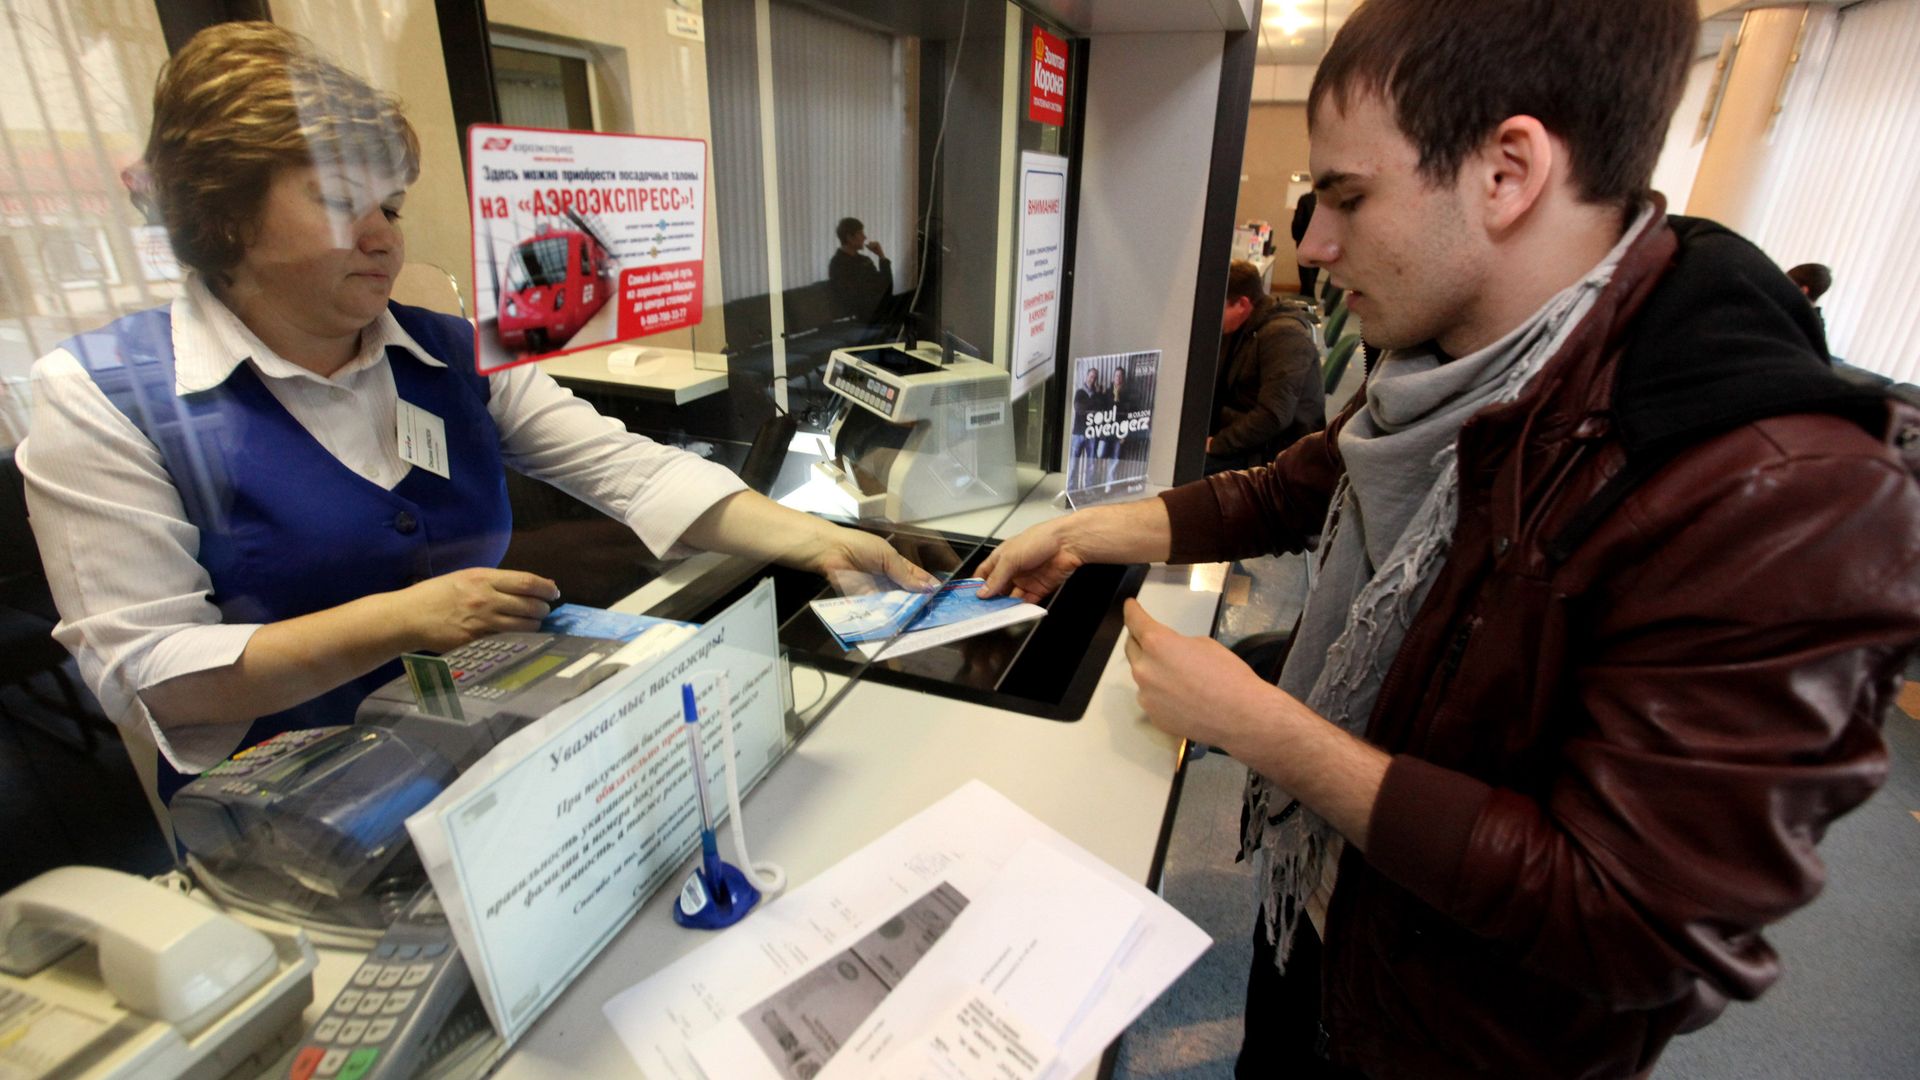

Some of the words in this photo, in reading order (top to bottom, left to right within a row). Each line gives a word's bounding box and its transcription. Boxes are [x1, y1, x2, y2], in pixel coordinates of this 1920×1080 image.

[1035, 60, 1064, 96] Корона
[480, 196, 509, 218] на
[518, 186, 694, 218] «АЭРОЭКСПРЕСС»!
[482, 166, 518, 182] Здесь
[523, 170, 558, 181] можно
[562, 168, 616, 183] приобрести
[619, 170, 669, 181] посадочные
[671, 171, 699, 181] талоны
[1085, 416, 1150, 439] avengerz
[1086, 405, 1117, 427] soul
[550, 691, 644, 770] Уважаемые
[649, 626, 724, 695] пассажиры!
[556, 791, 581, 817] При
[584, 744, 638, 794] получении
[641, 710, 680, 747] билетов
[595, 745, 659, 803] обязательно
[486, 835, 578, 917] правильность
[581, 781, 637, 839] указанных
[523, 851, 579, 907] фамилии
[582, 842, 589, 854] и
[592, 806, 630, 845] номера
[560, 842, 614, 892] личность,
[617, 829, 624, 840] а
